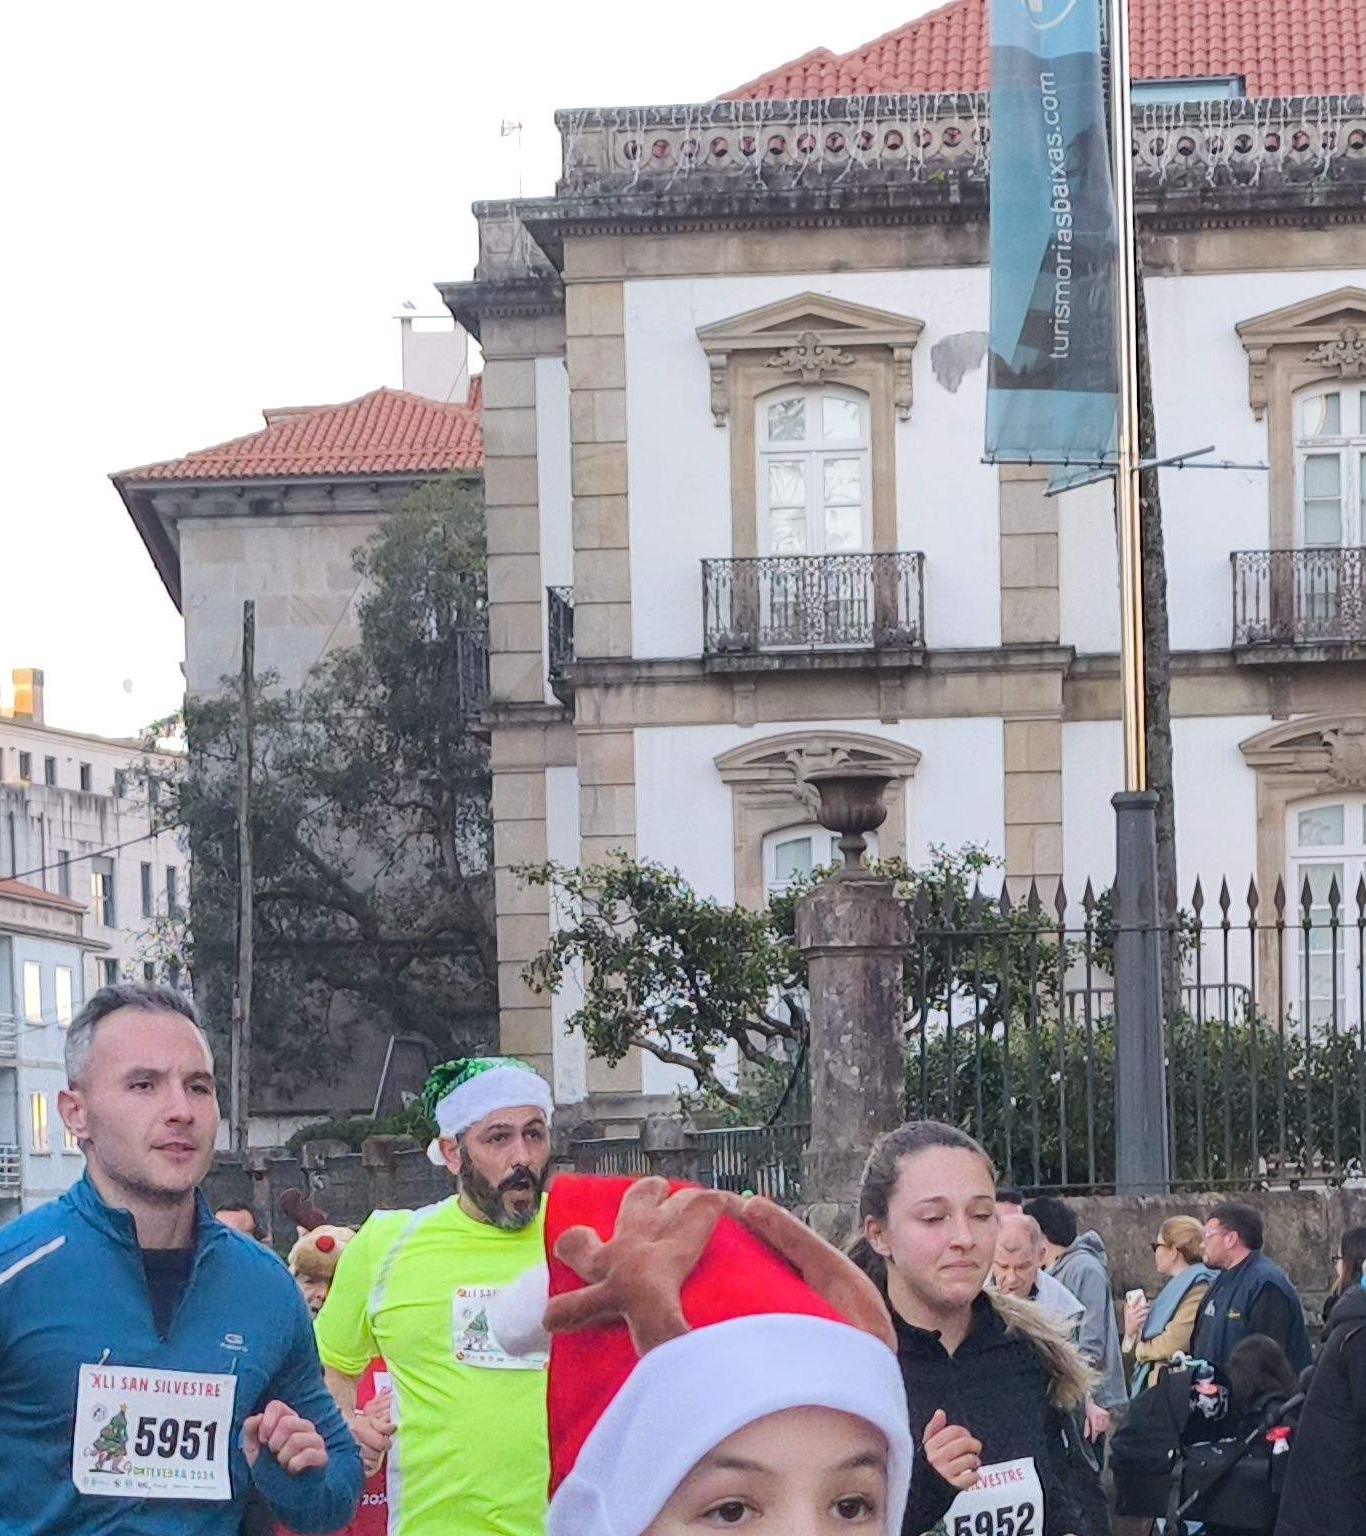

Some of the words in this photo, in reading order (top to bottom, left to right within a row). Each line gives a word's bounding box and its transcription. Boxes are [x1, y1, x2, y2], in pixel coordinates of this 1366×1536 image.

[1038, 71, 1073, 361] turismoriasbaixas.com
[91, 1374, 115, 1389] XLI
[121, 1377, 148, 1392] SAN
[153, 1380, 221, 1397] SILVESTRE
[135, 1416, 218, 1461] 5951
[971, 1467, 1026, 1490] LVESTRE
